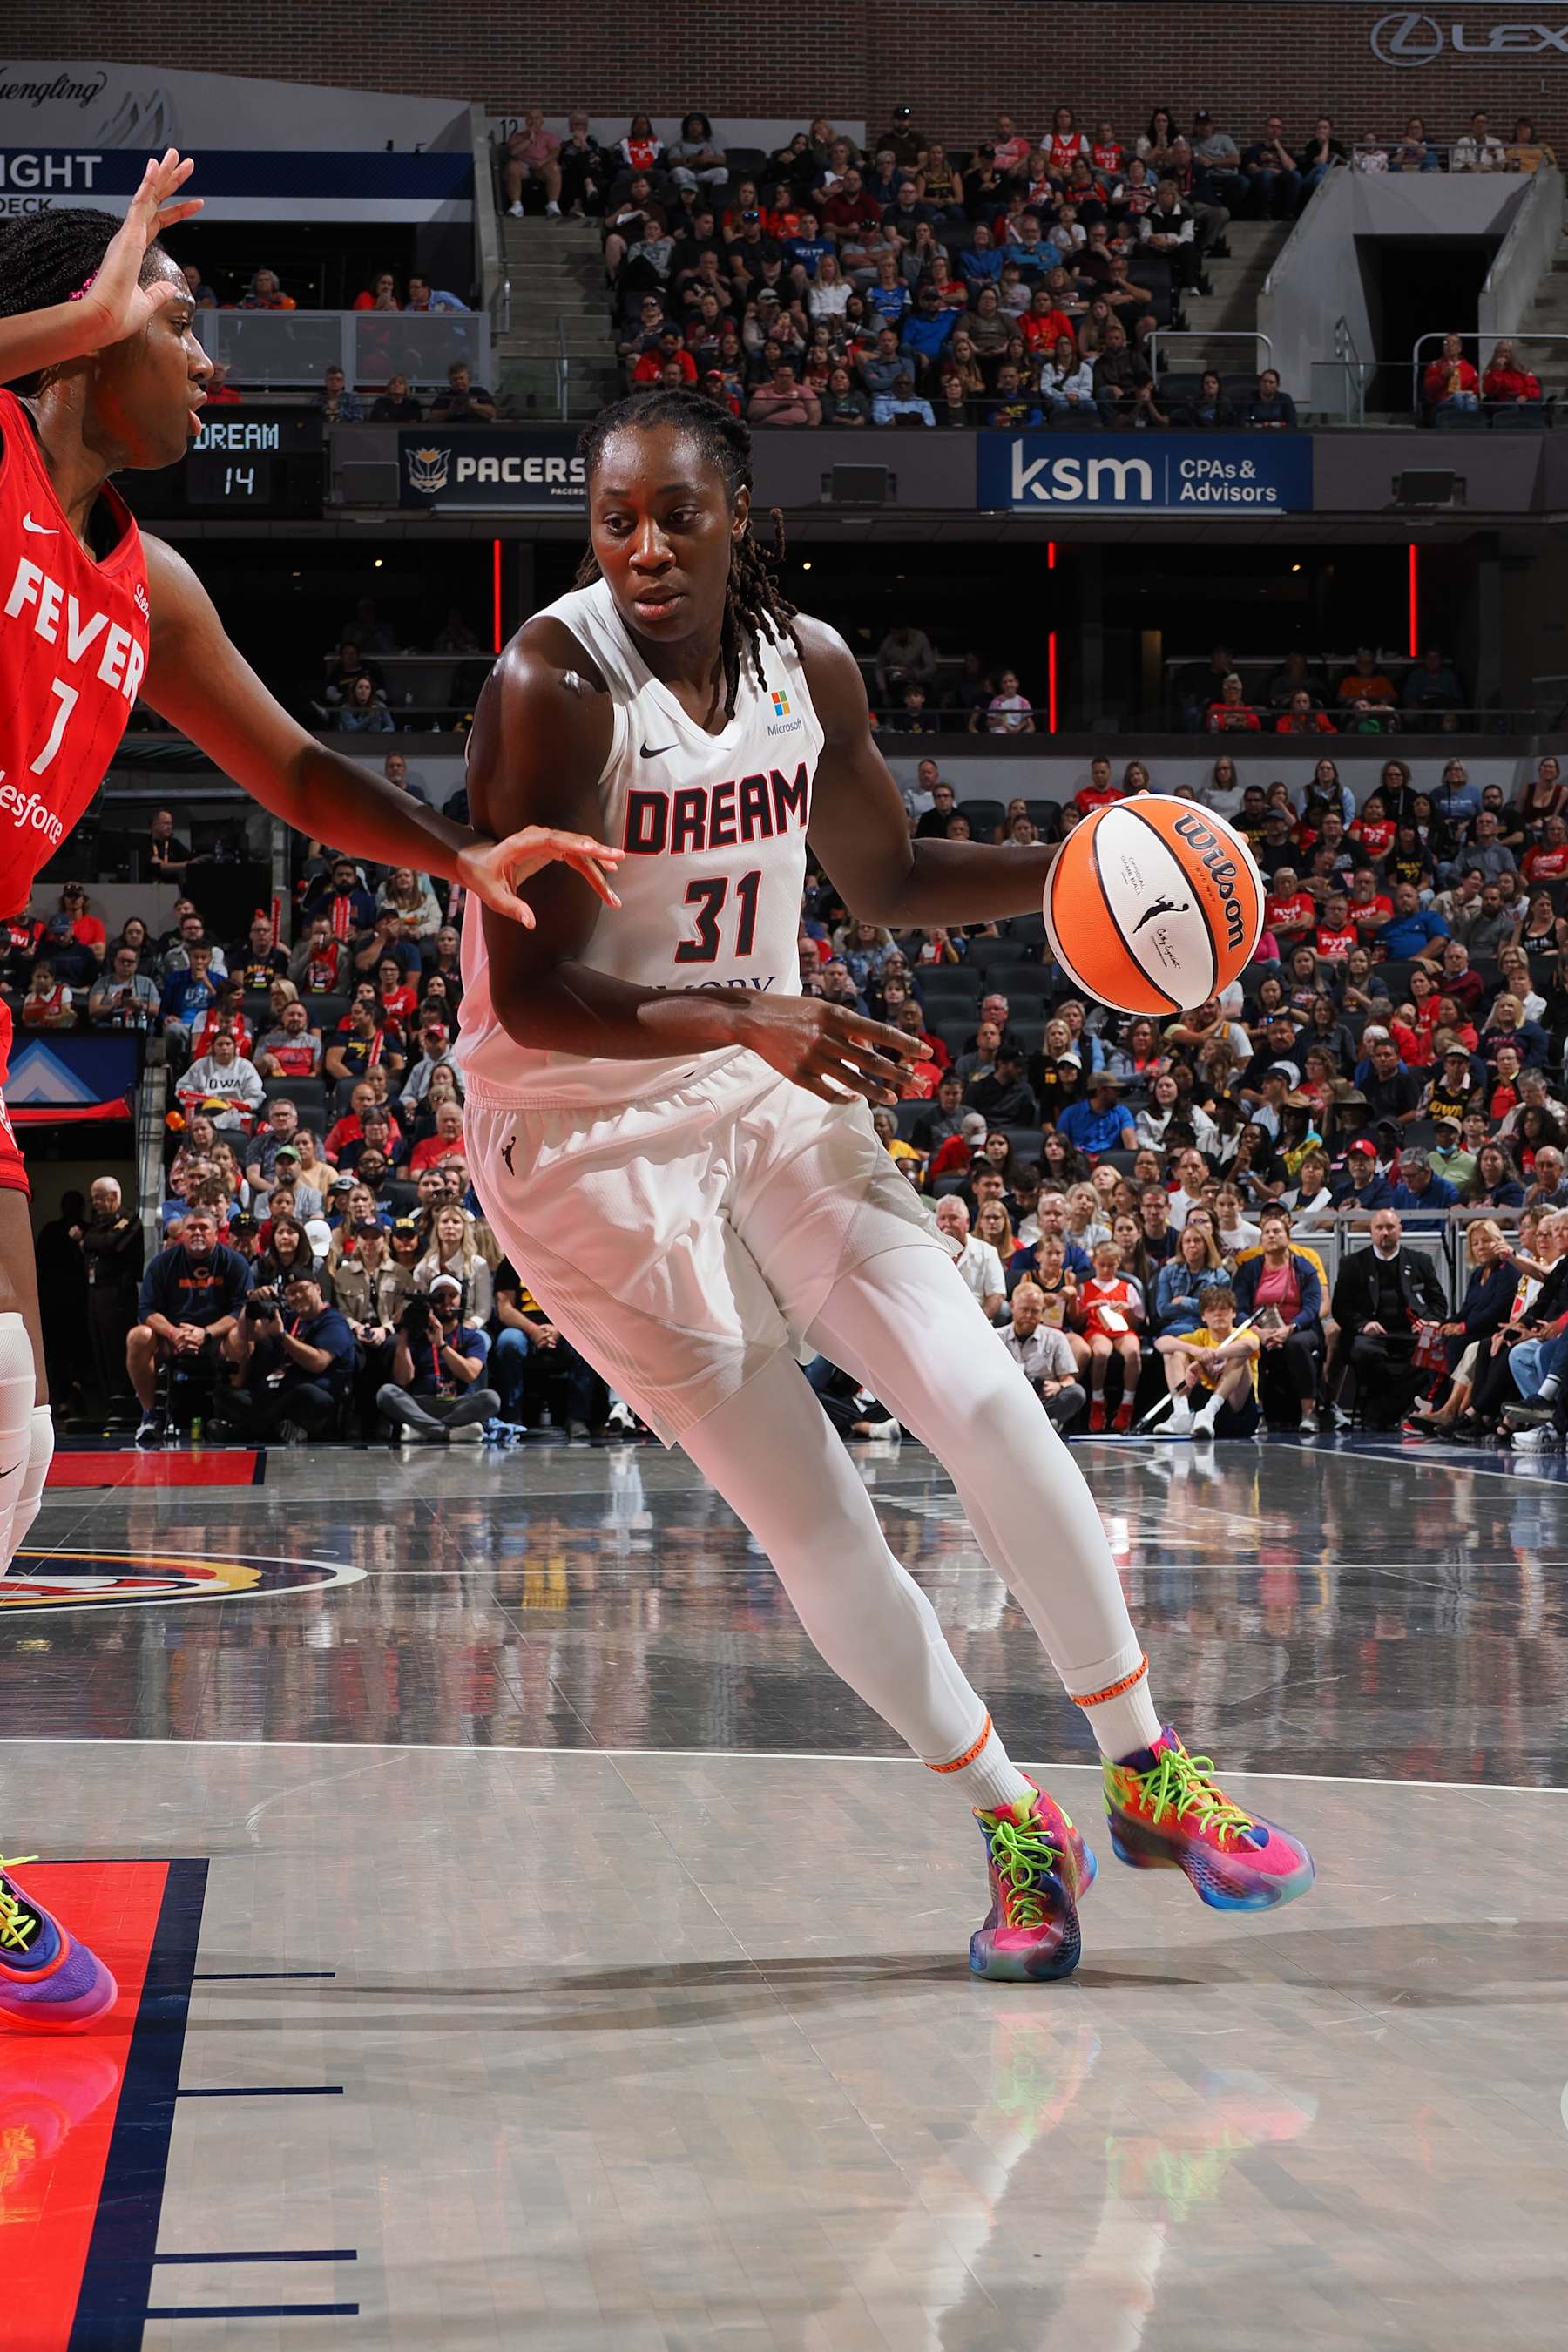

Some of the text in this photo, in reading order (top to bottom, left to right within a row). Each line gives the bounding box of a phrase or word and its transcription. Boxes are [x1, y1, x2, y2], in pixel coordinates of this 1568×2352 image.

[1451, 24, 1568, 53] LEX
[0, 67, 107, 108] uengling
[193, 423, 279, 449] DREAM
[225, 467, 254, 495] 14
[456, 457, 586, 483] PACERS
[1011, 438, 1152, 501] ksm
[1179, 459, 1256, 479] CPAs &
[1179, 482, 1277, 502] Advisors
[4, 558, 145, 711] FEVER
[30, 677, 79, 775] 7
[767, 718, 802, 736] Microsoft
[623, 760, 810, 856] DREAM
[1173, 814, 1245, 953] Wilson
[673, 868, 762, 964] 31
[1329, 943, 1347, 952] 22
[205, 1078, 241, 1090] IOWA
